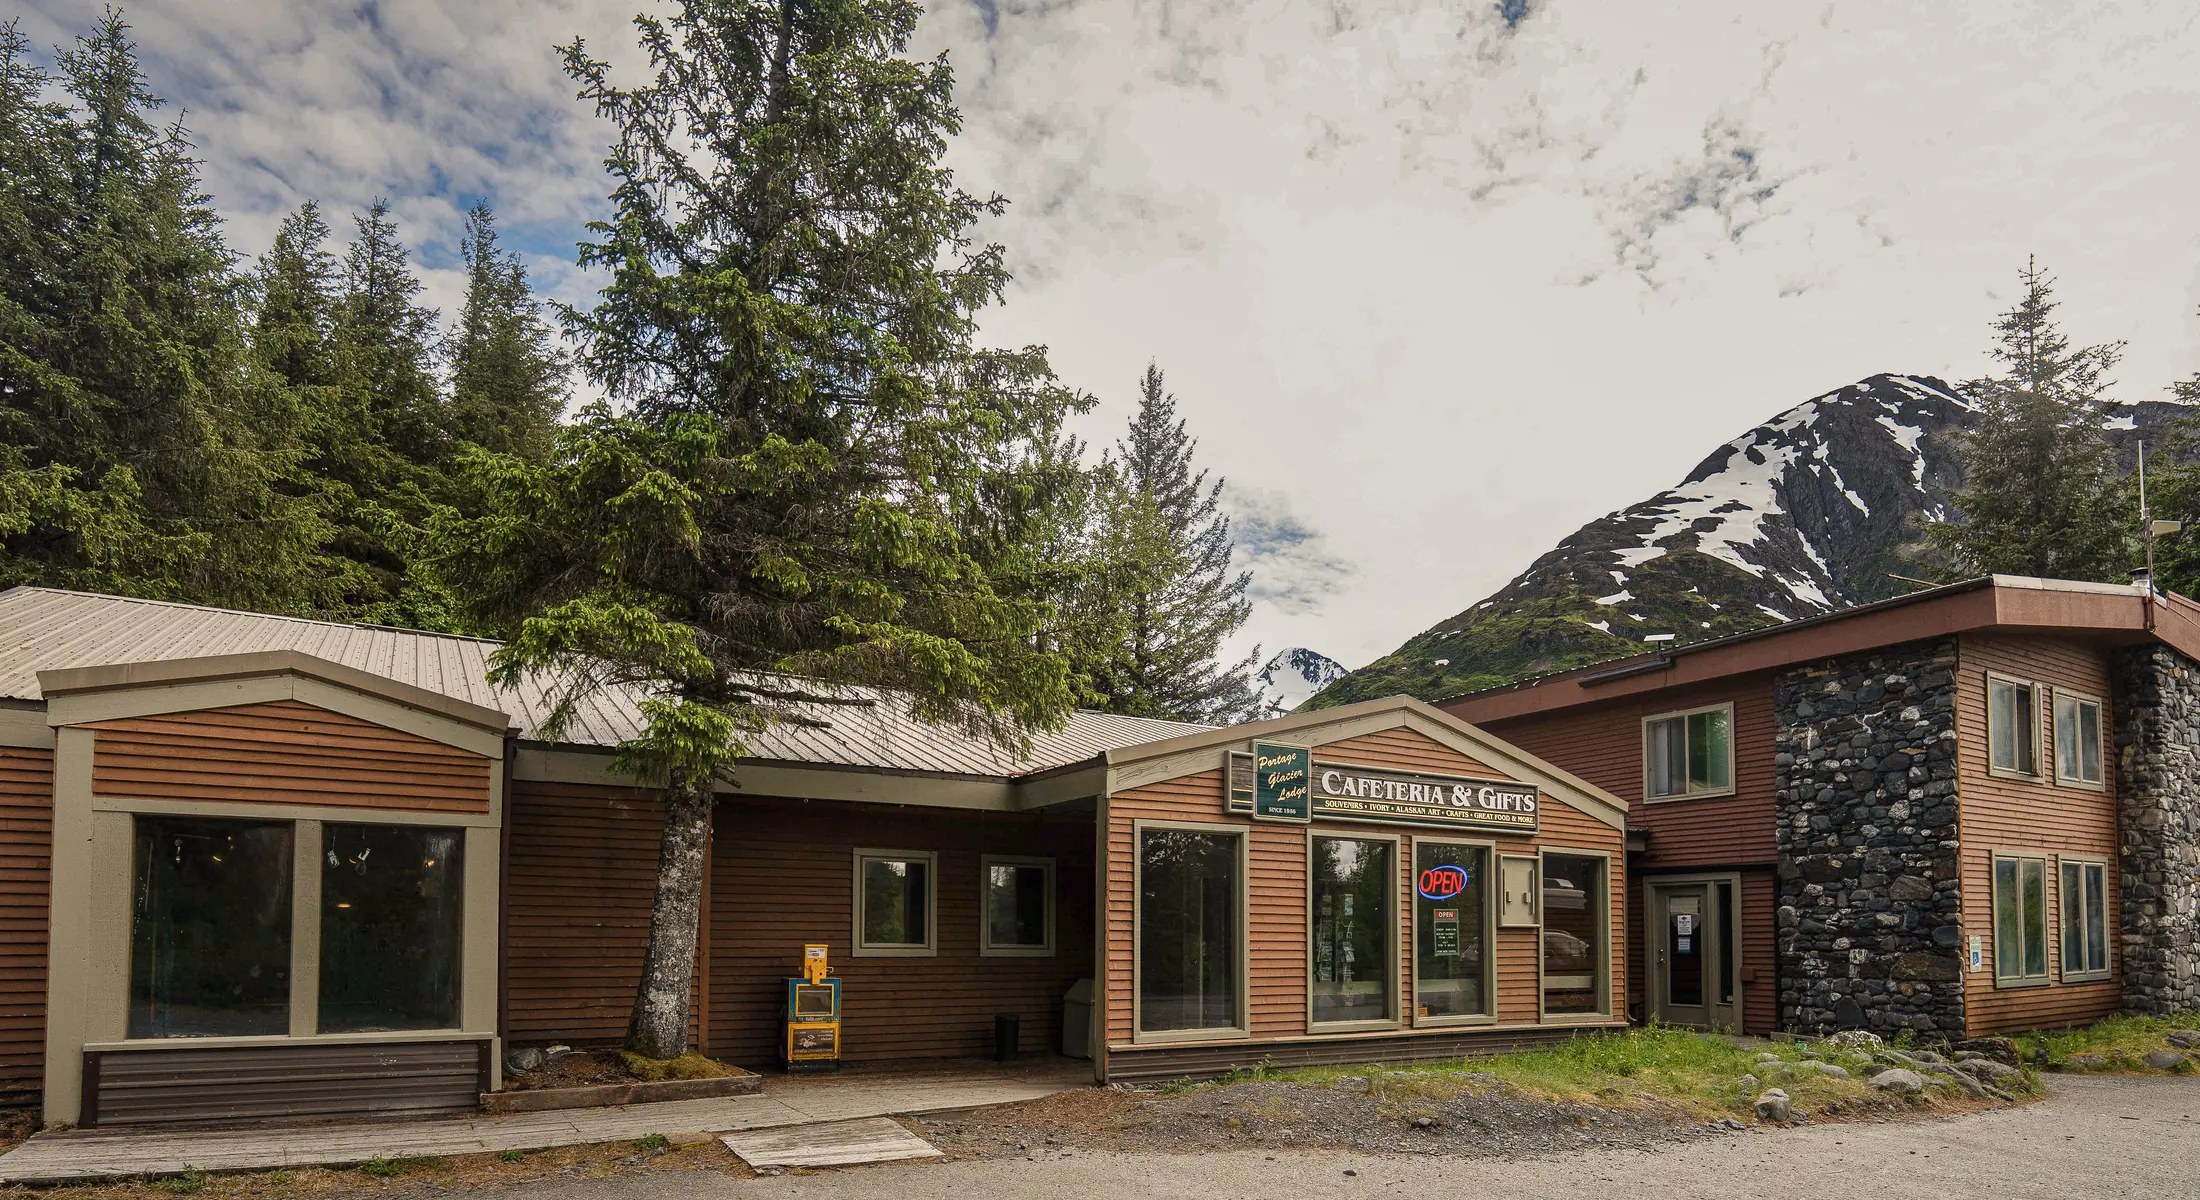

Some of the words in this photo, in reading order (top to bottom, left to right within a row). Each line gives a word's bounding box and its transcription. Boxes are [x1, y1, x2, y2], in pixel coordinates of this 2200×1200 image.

[1258, 753, 1297, 770] Portage
[1268, 770, 1304, 789] Glacier
[1277, 786, 1308, 802] Lodge
[1321, 770, 1445, 805] CAFETERIA
[1451, 784, 1472, 807] &
[1478, 787, 1535, 812] GIFTS
[1268, 806, 1284, 814] SINCE
[1325, 800, 1363, 810] SOUVENIRS
[1369, 803, 1390, 812] IVORY
[1395, 805, 1425, 815] ALASKAN
[1427, 808, 1441, 816] ART
[1446, 809, 1469, 818] CRAFTS
[1474, 812, 1493, 820] GREAT
[1494, 814, 1511, 822] FOOD
[1517, 815, 1534, 823] MORE
[1419, 869, 1463, 894] OPEN
